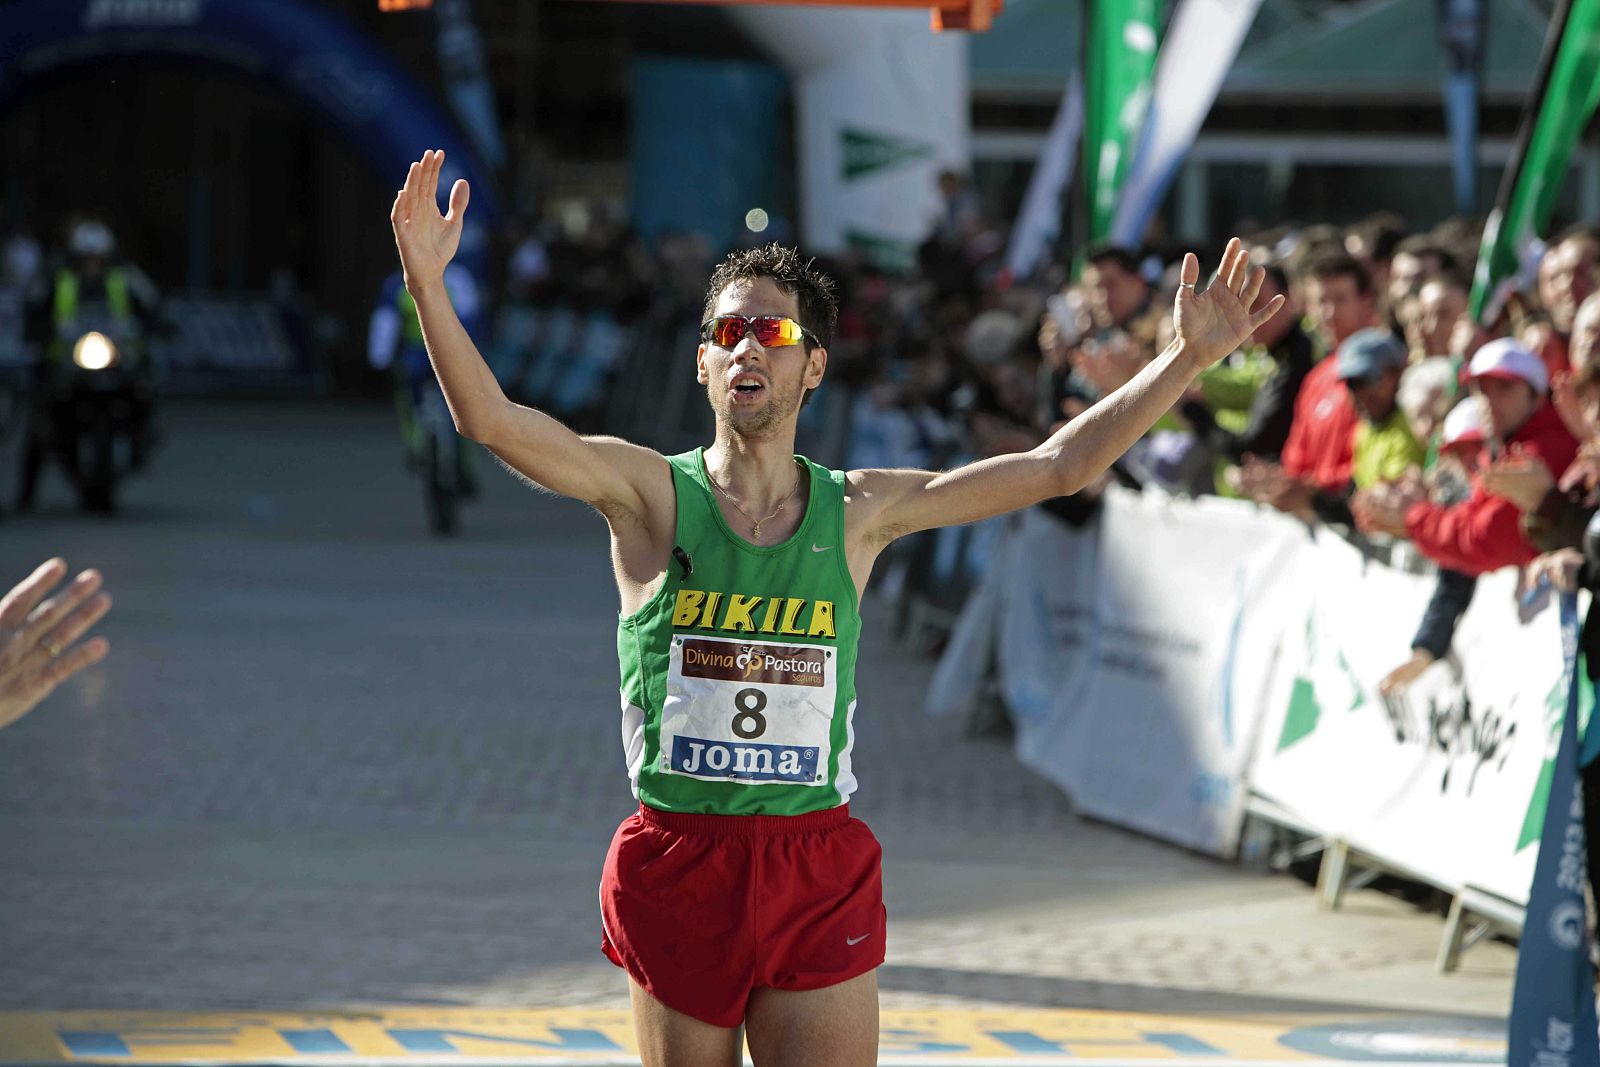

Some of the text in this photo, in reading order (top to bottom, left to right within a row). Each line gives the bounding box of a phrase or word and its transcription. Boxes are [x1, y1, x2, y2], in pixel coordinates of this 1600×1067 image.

[672, 589, 837, 638] BIKILA
[686, 648, 822, 674] Divina Pastora
[731, 688, 767, 739] 8
[57, 1026, 1234, 1057] FINH
